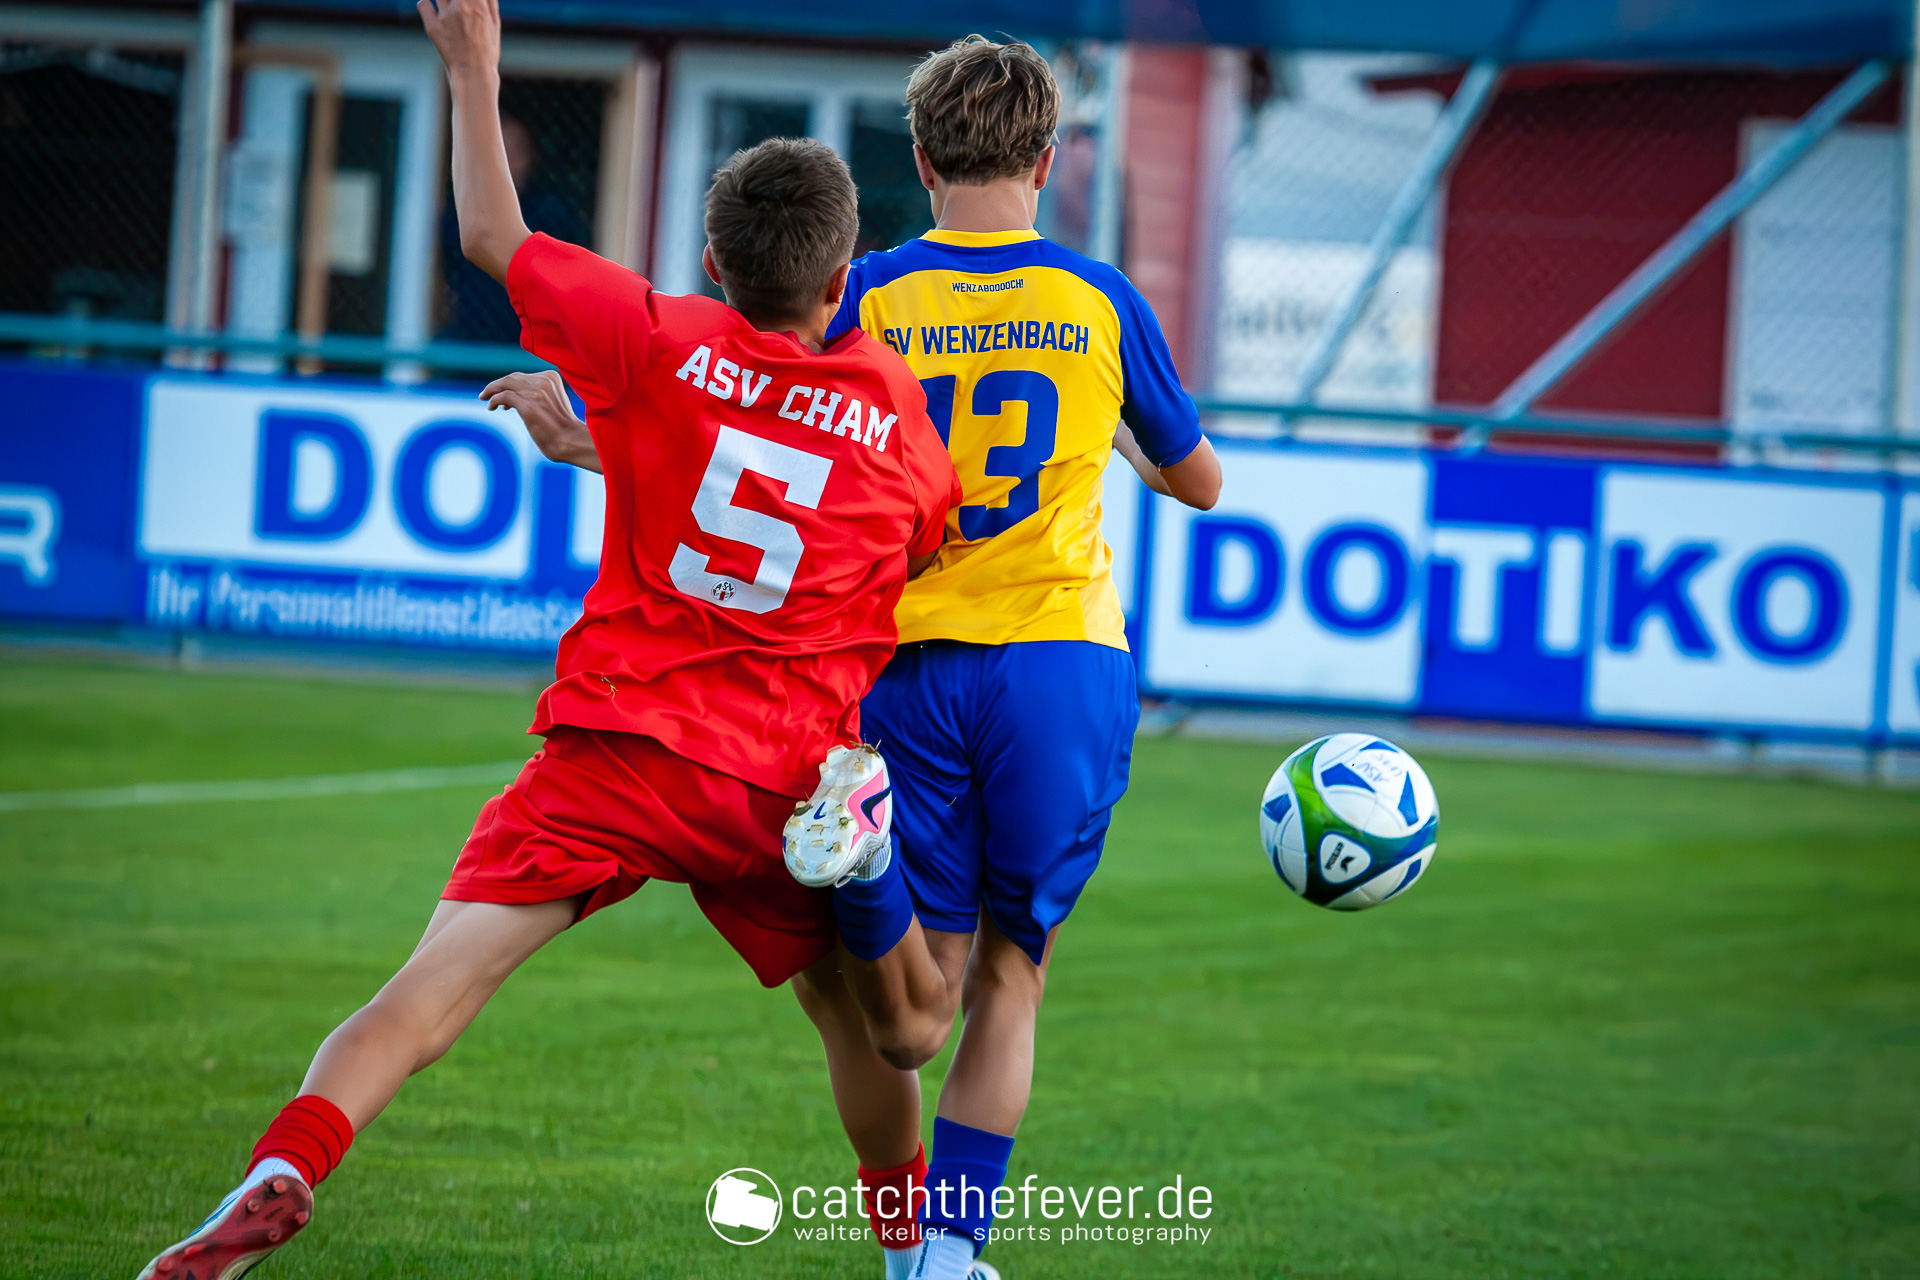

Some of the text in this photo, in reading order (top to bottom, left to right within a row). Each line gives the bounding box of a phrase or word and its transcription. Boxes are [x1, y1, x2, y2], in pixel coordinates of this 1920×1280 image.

[675, 344, 899, 453] ASV CHAM
[884, 320, 1090, 355] SV WENZENBACH
[667, 424, 834, 615] 5
[1185, 513, 1849, 666] DOTIKO
